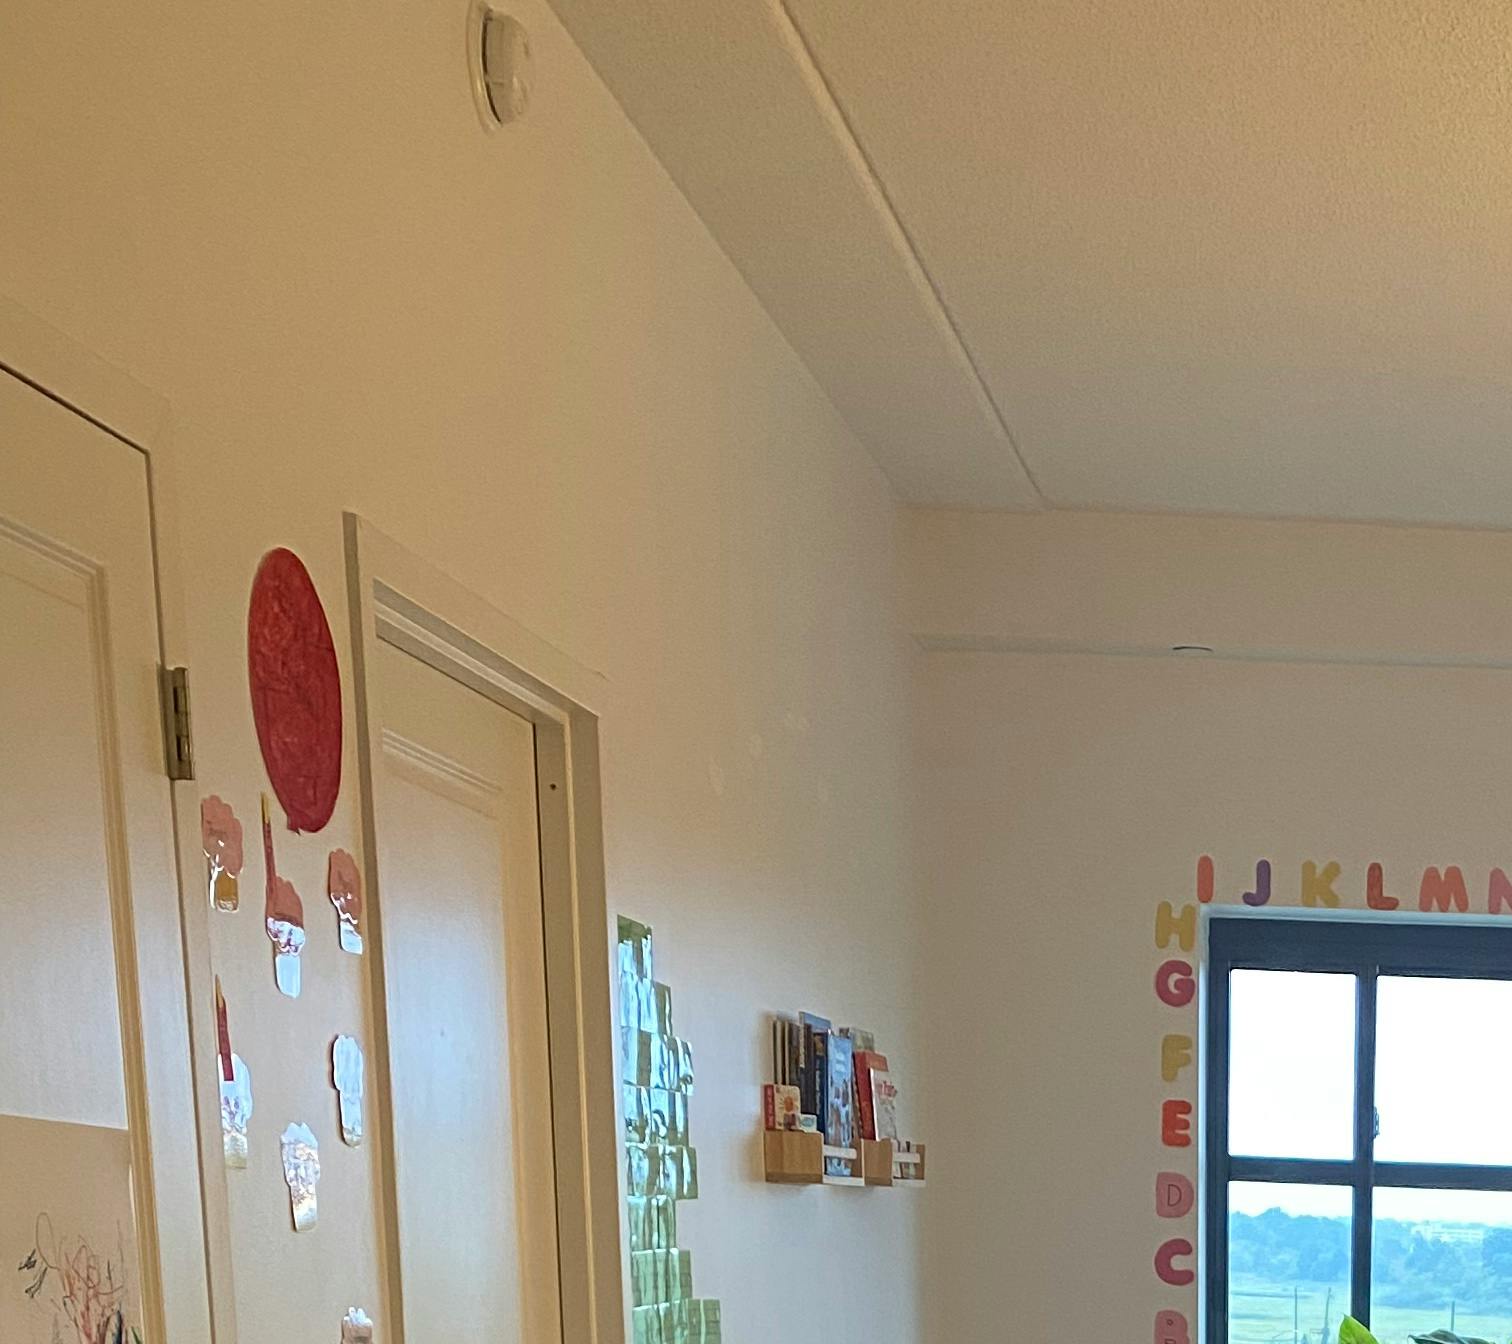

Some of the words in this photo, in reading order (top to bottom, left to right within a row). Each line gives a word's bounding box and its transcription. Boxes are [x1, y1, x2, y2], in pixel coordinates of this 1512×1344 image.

[1197, 855, 1214, 903] I
[1242, 859, 1272, 906] J
[1302, 860, 1342, 908] K
[1366, 862, 1399, 911] L
[1418, 865, 1470, 913] M
[1155, 900, 1197, 952] H
[1155, 959, 1196, 1008] G
[1161, 1034, 1193, 1083] F
[1161, 1099, 1193, 1148] E
[1155, 1171, 1195, 1219] D
[1154, 1238, 1195, 1286] C
